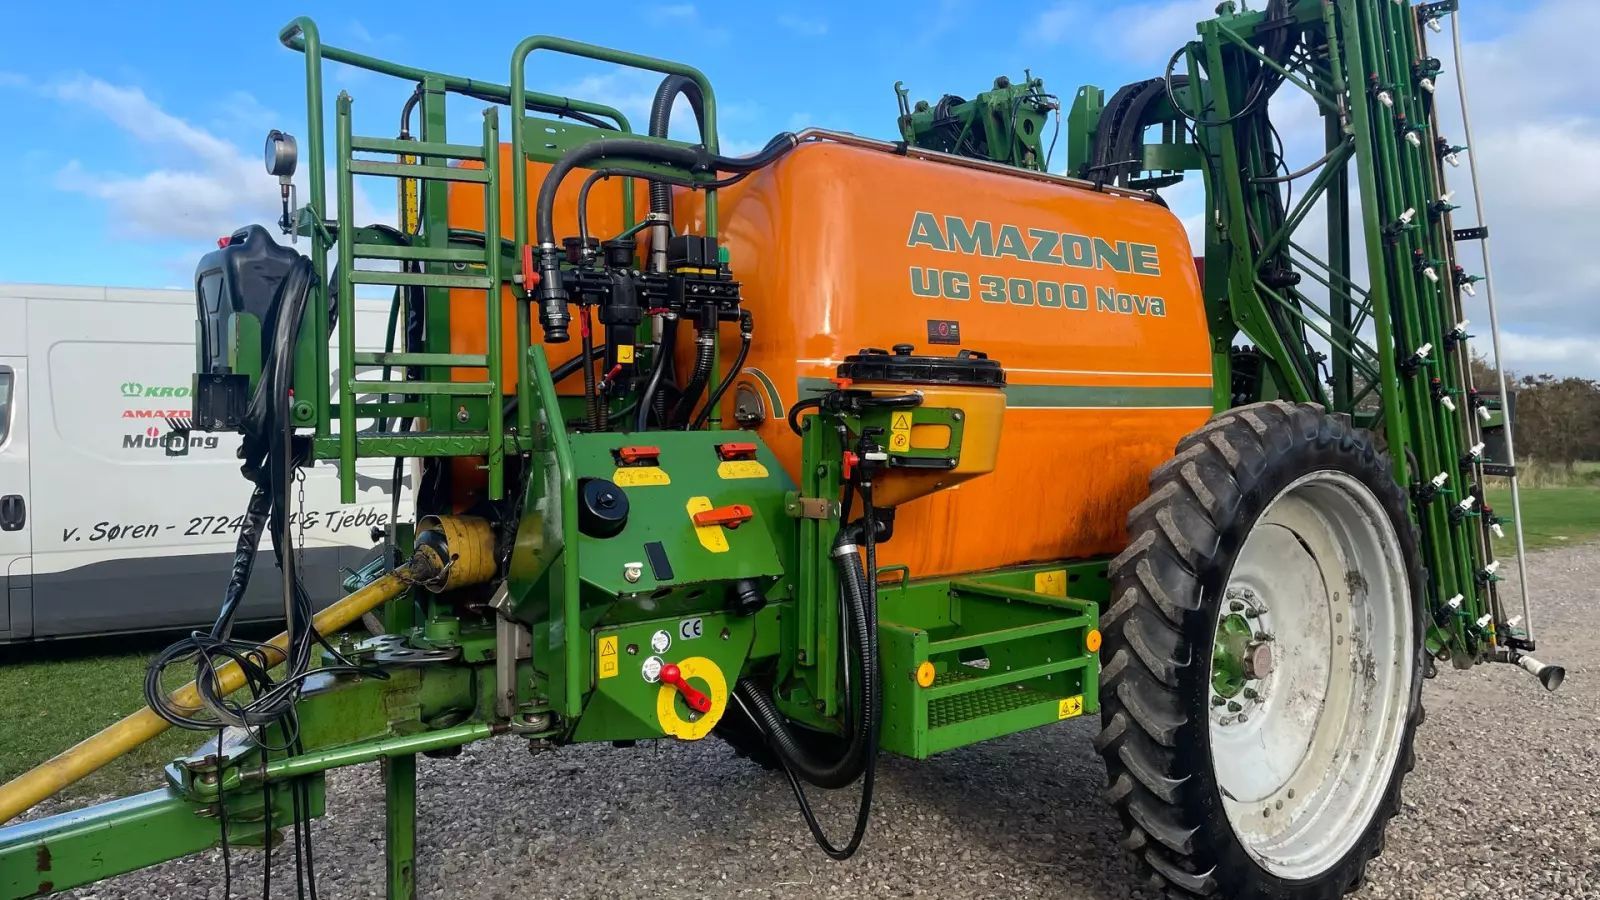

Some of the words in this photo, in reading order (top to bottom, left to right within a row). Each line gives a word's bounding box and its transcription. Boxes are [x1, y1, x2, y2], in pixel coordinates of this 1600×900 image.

[907, 211, 1161, 277] AMAZONE
[910, 266, 971, 300] UG
[979, 274, 1088, 310] 3000
[1096, 286, 1167, 317] Nova
[145, 386, 192, 397] KRO
[121, 410, 191, 418] AMAZO
[63, 527, 81, 542] v.
[89, 521, 159, 543] Søren
[302, 511, 320, 530] &
[325, 506, 388, 533] Tjebbe
